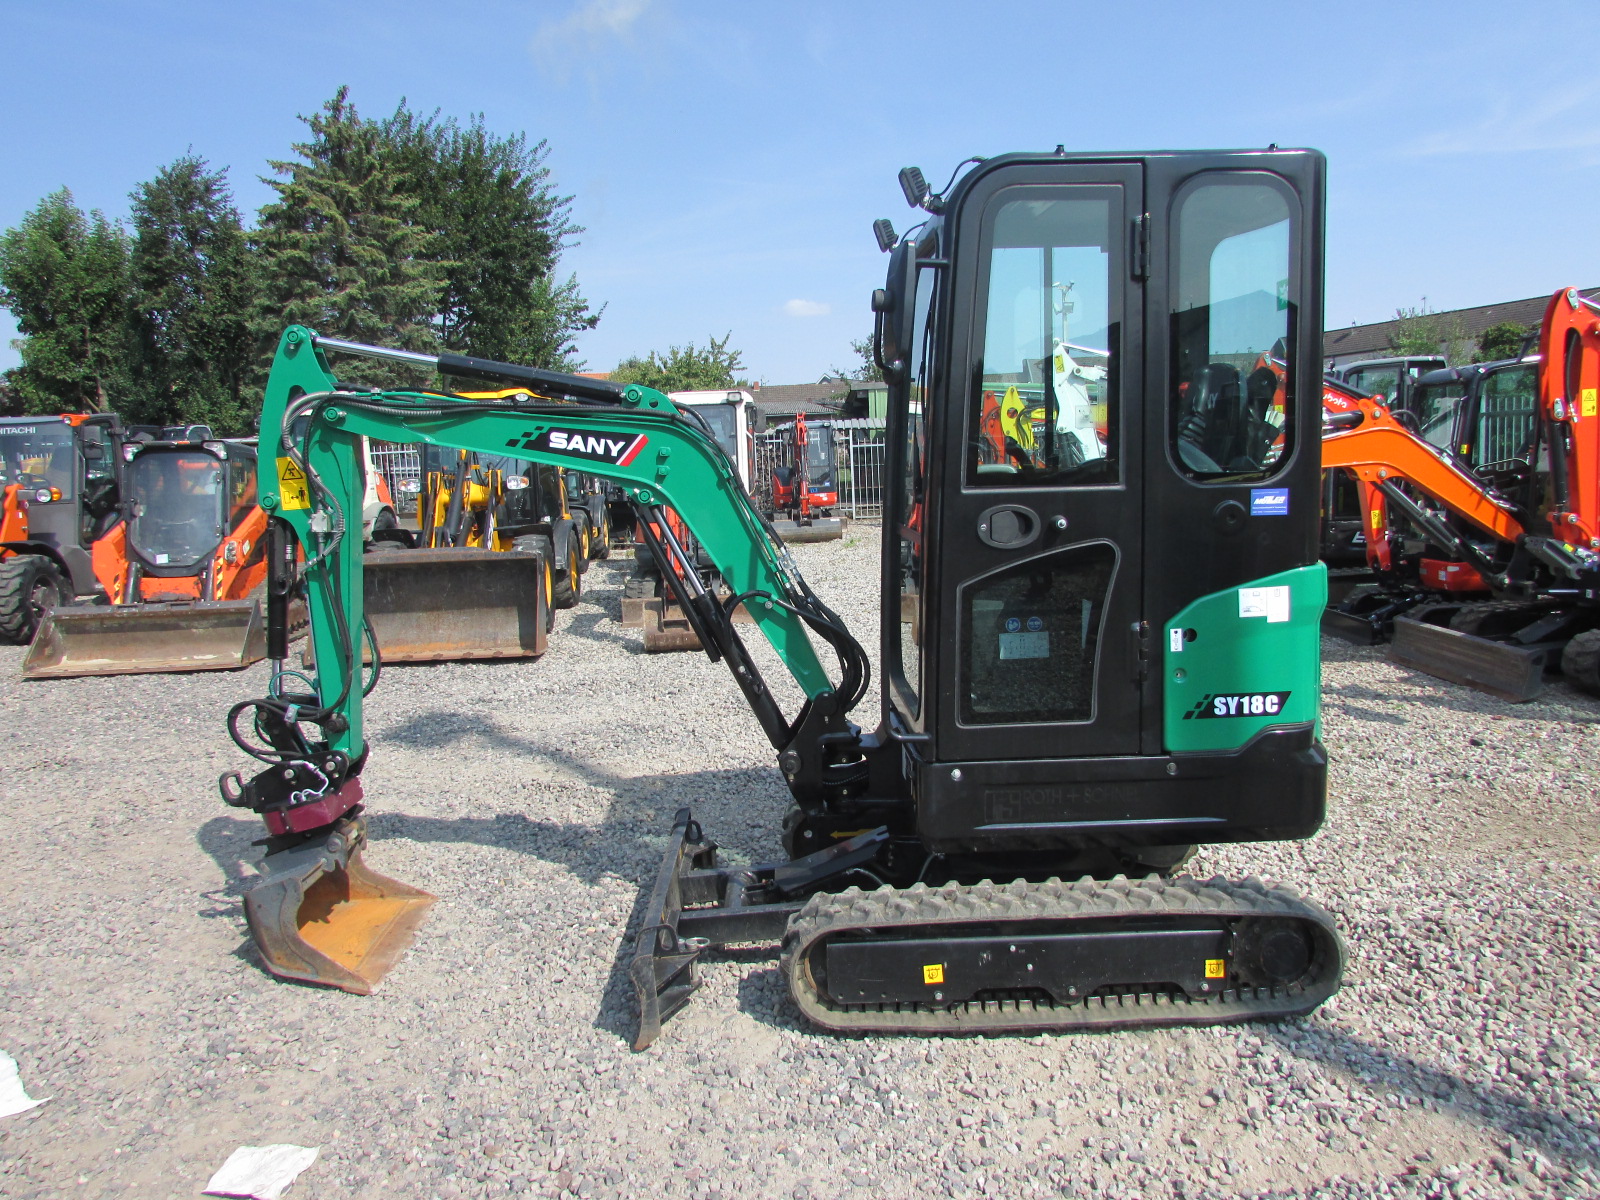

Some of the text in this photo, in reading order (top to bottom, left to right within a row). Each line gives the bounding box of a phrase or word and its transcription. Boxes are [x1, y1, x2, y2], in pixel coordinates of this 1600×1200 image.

[549, 431, 626, 457] SANY
[1213, 694, 1279, 716] SY18C
[1023, 788, 1062, 805] ROTH
